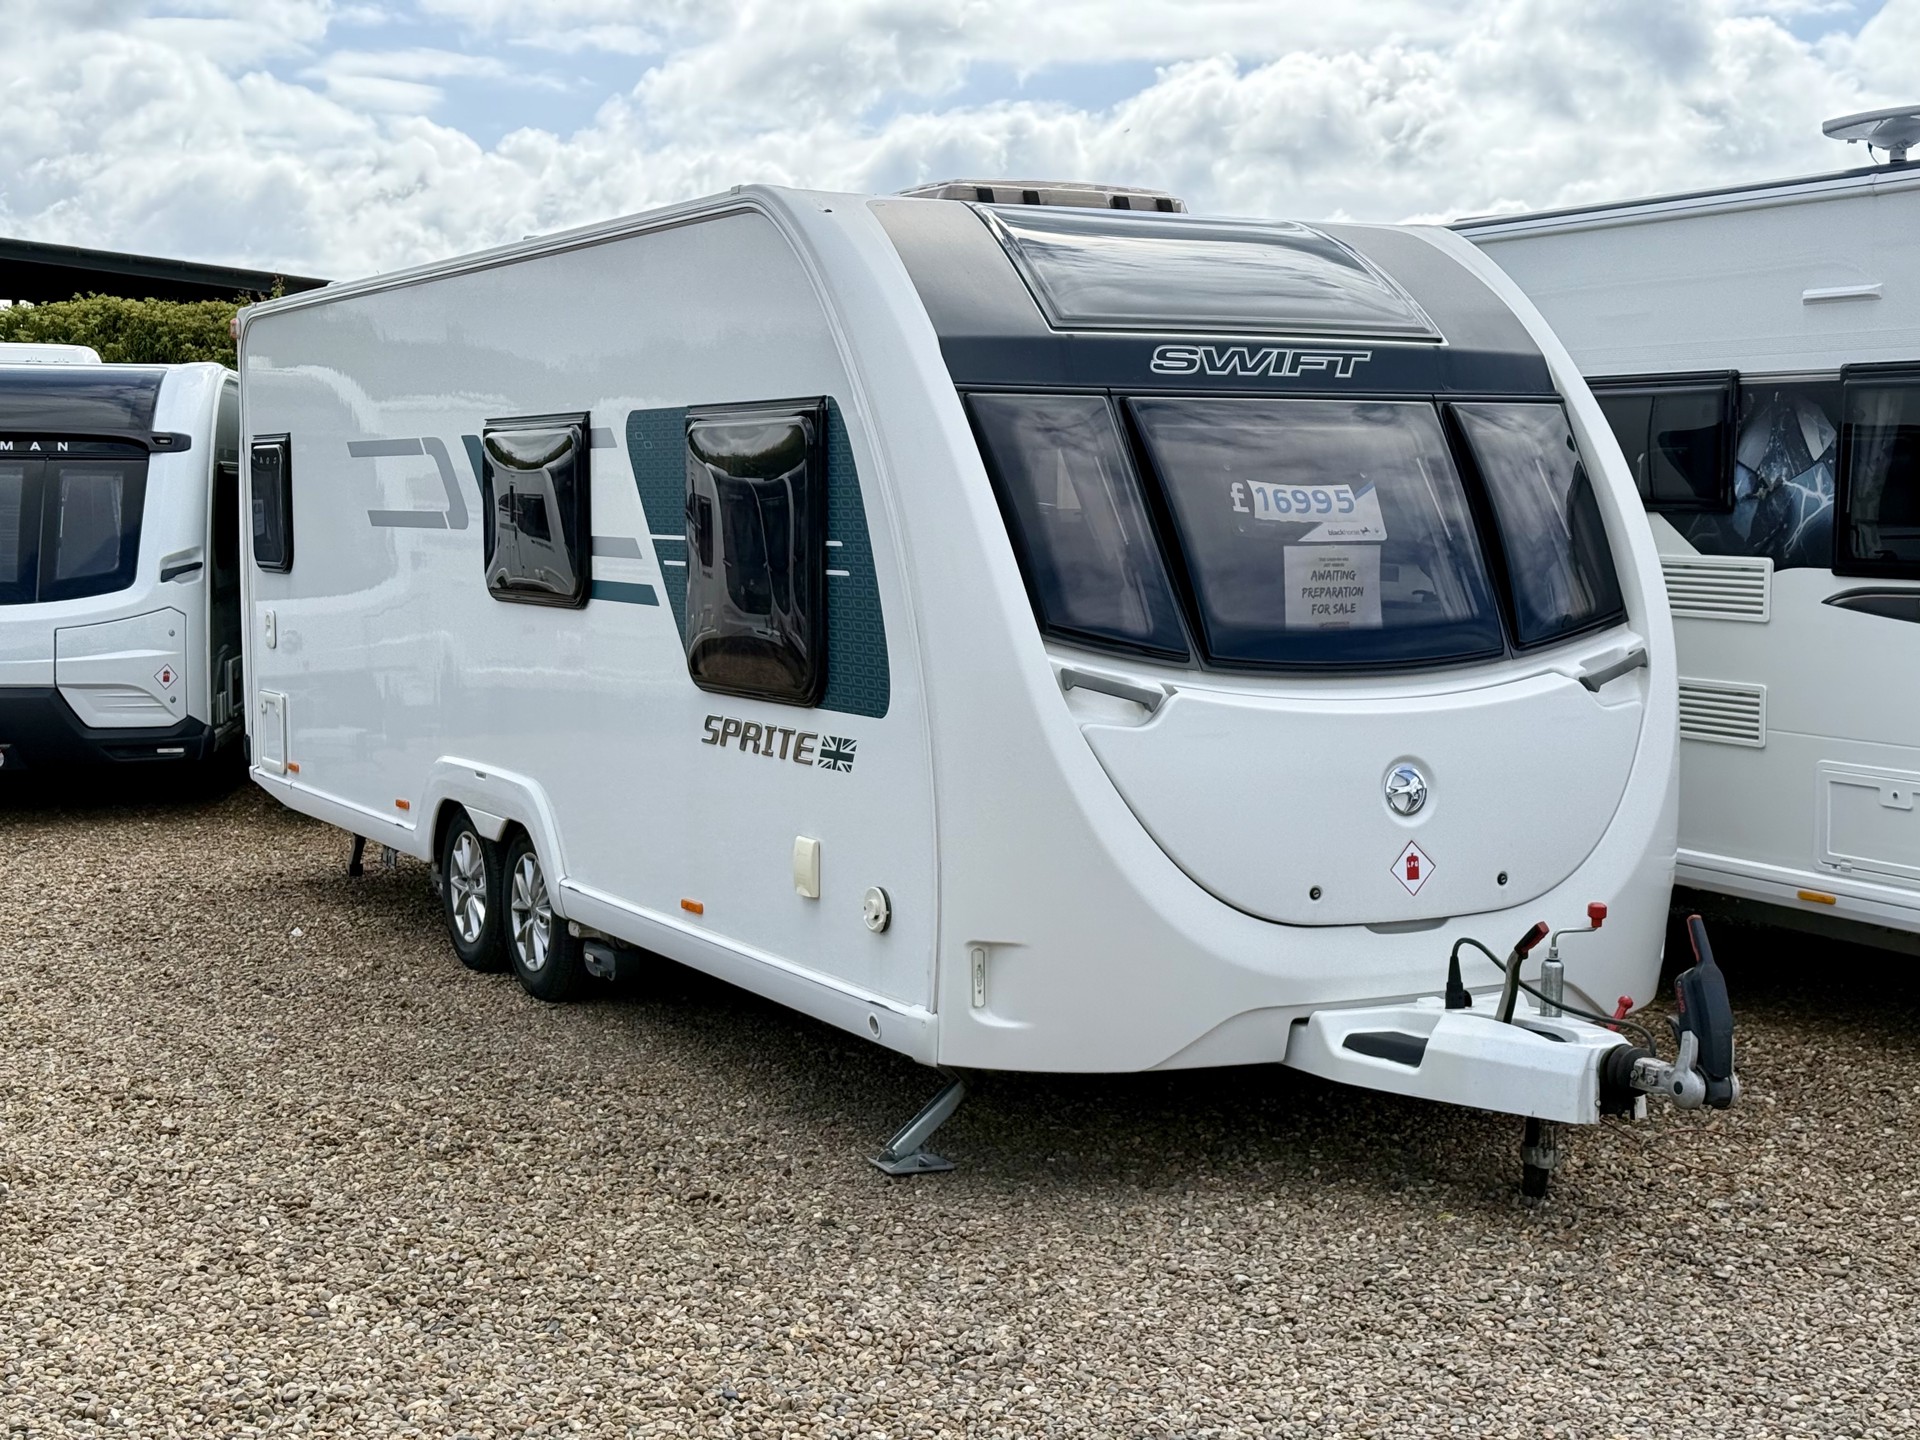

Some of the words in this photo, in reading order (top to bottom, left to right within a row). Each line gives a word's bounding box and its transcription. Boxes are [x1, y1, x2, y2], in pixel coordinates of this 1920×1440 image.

[1151, 345, 1372, 378] SWIFT
[0, 440, 69, 452] MAN
[1310, 569, 1357, 581] AWAITING
[1301, 586, 1364, 599] PREPARATION
[1311, 604, 1331, 616] FOR
[1333, 603, 1356, 615] SALE
[701, 713, 818, 766] SPRITE
